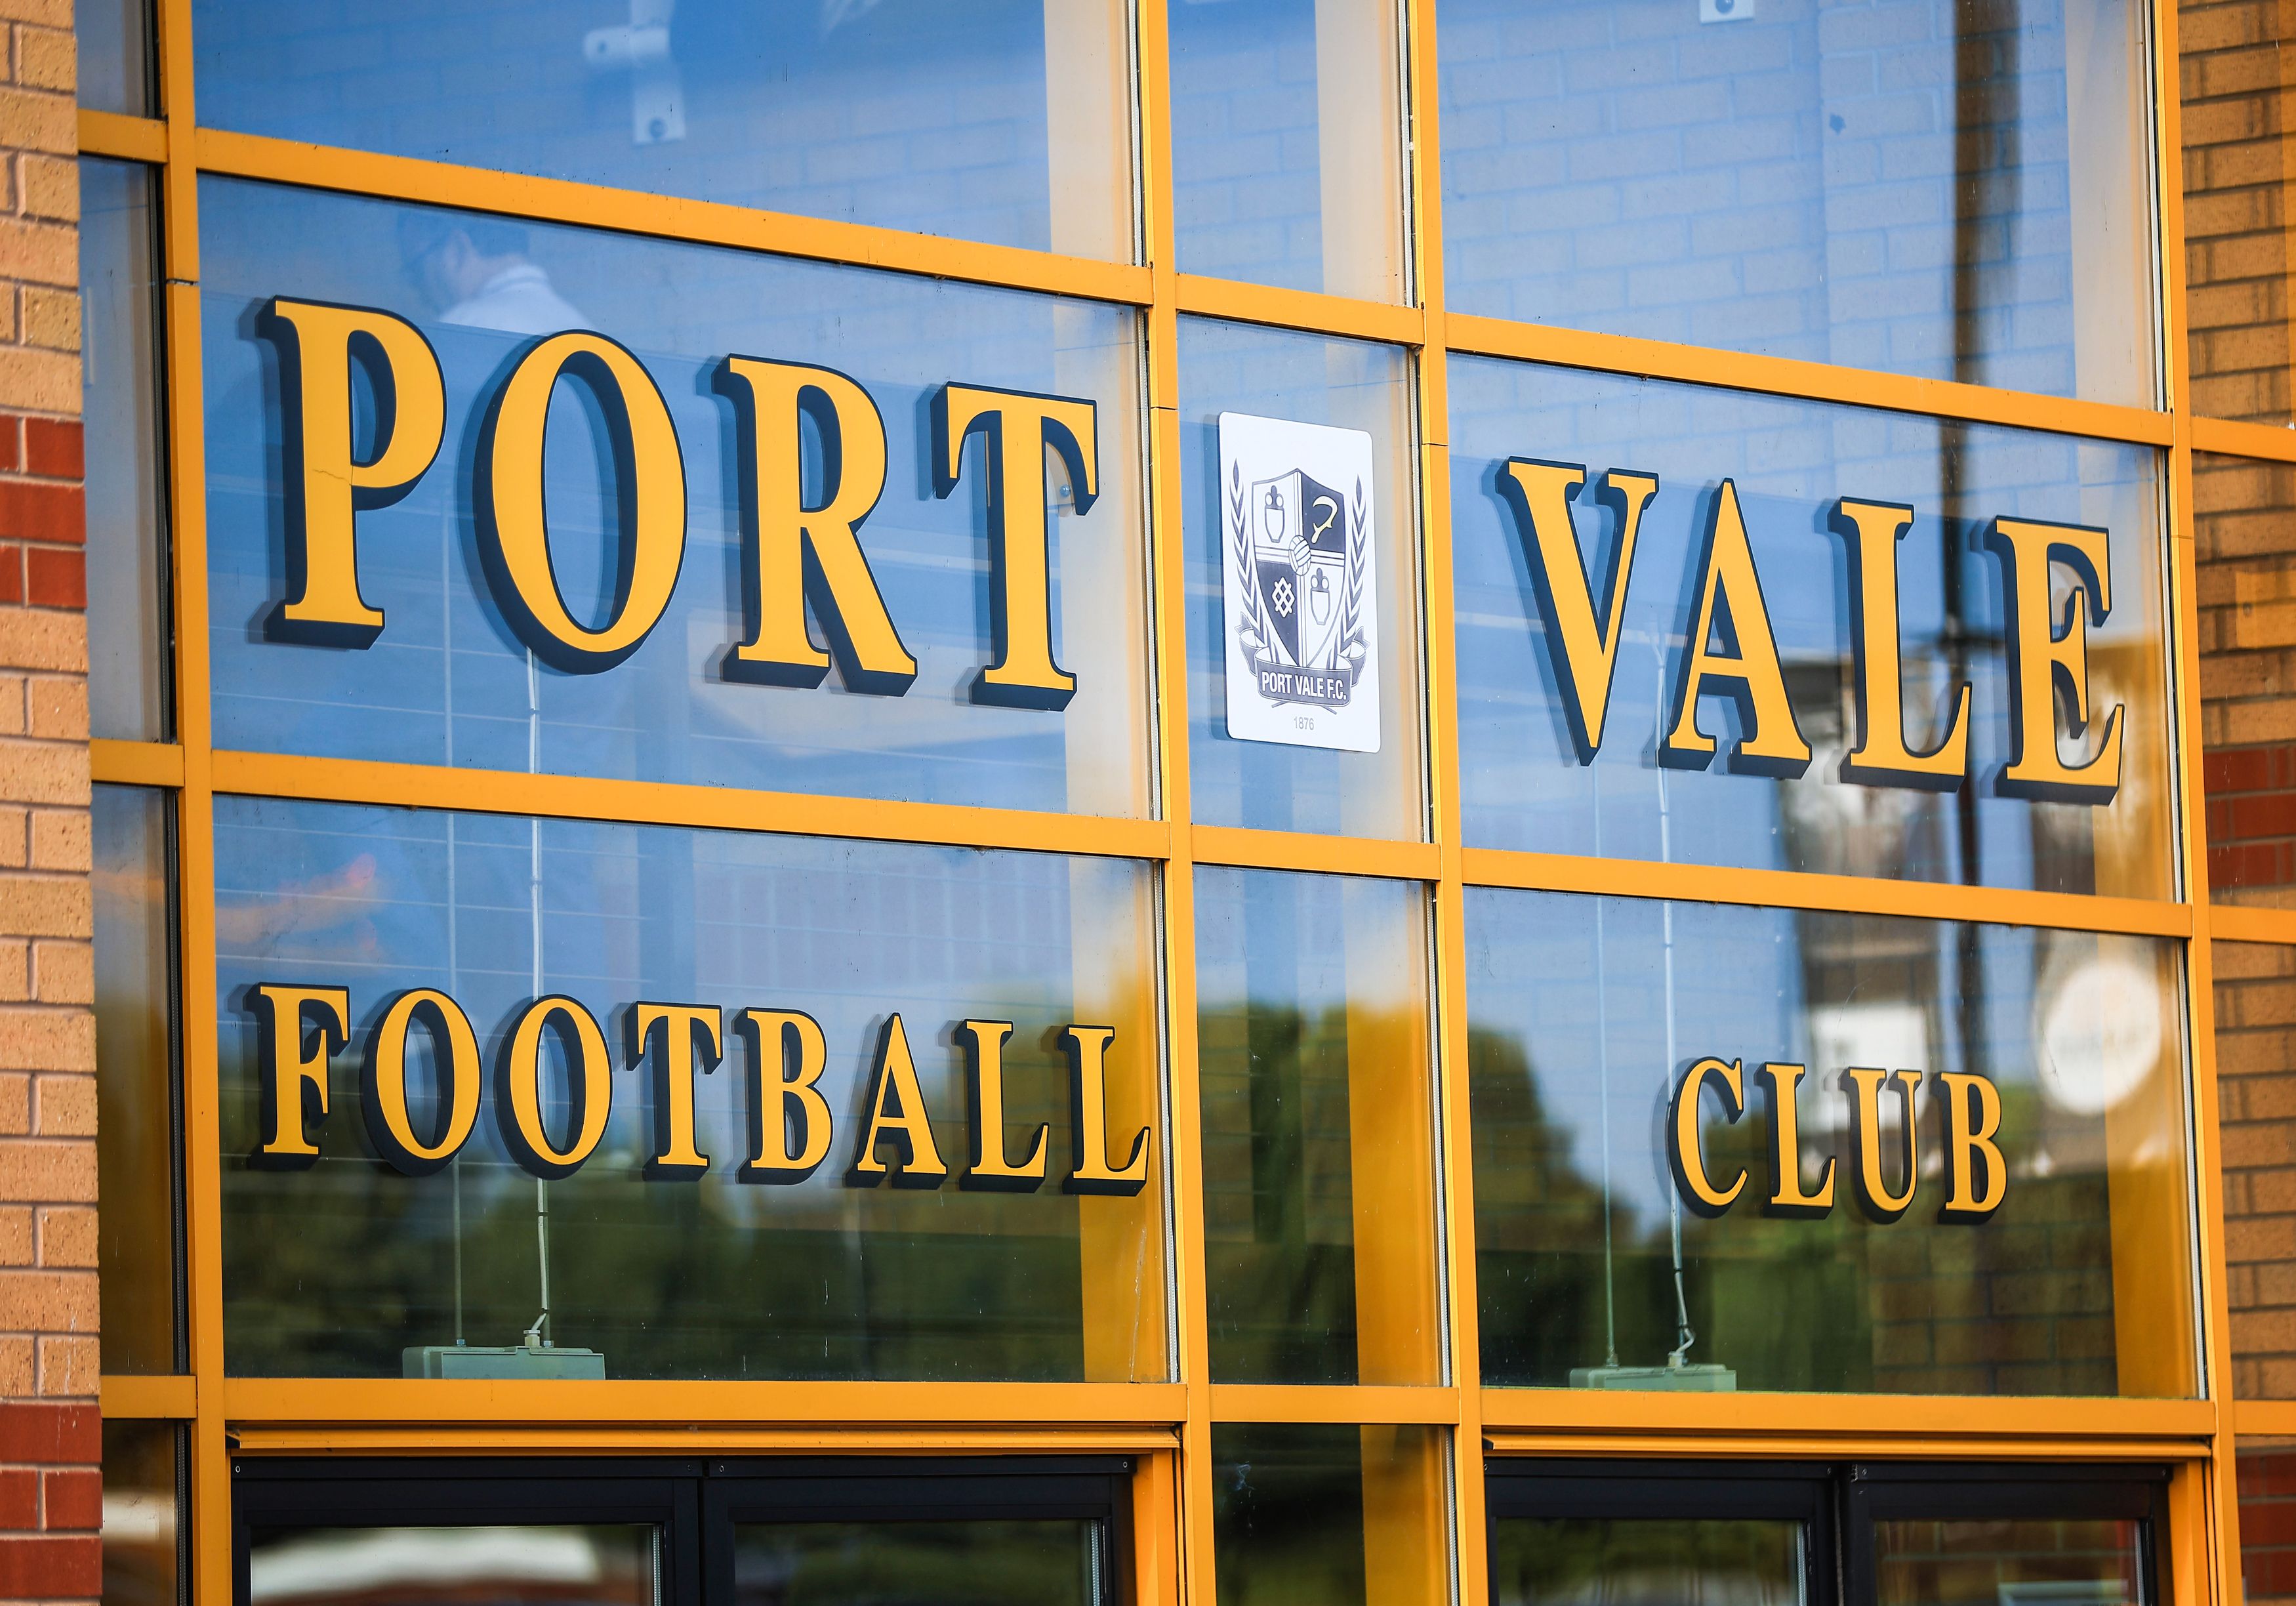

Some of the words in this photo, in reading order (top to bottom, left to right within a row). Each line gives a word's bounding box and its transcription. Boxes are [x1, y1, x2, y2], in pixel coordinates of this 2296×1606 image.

[255, 295, 1099, 712] PORT
[1494, 456, 2125, 806] VALE
[1261, 671, 1292, 693] PORT
[1294, 675, 1324, 697] VALE
[1326, 678, 1347, 701] F.C.
[1293, 716, 1315, 731] 1876
[243, 983, 1150, 1197] FOOTBALL
[1668, 1056, 2008, 1225] CLUB
